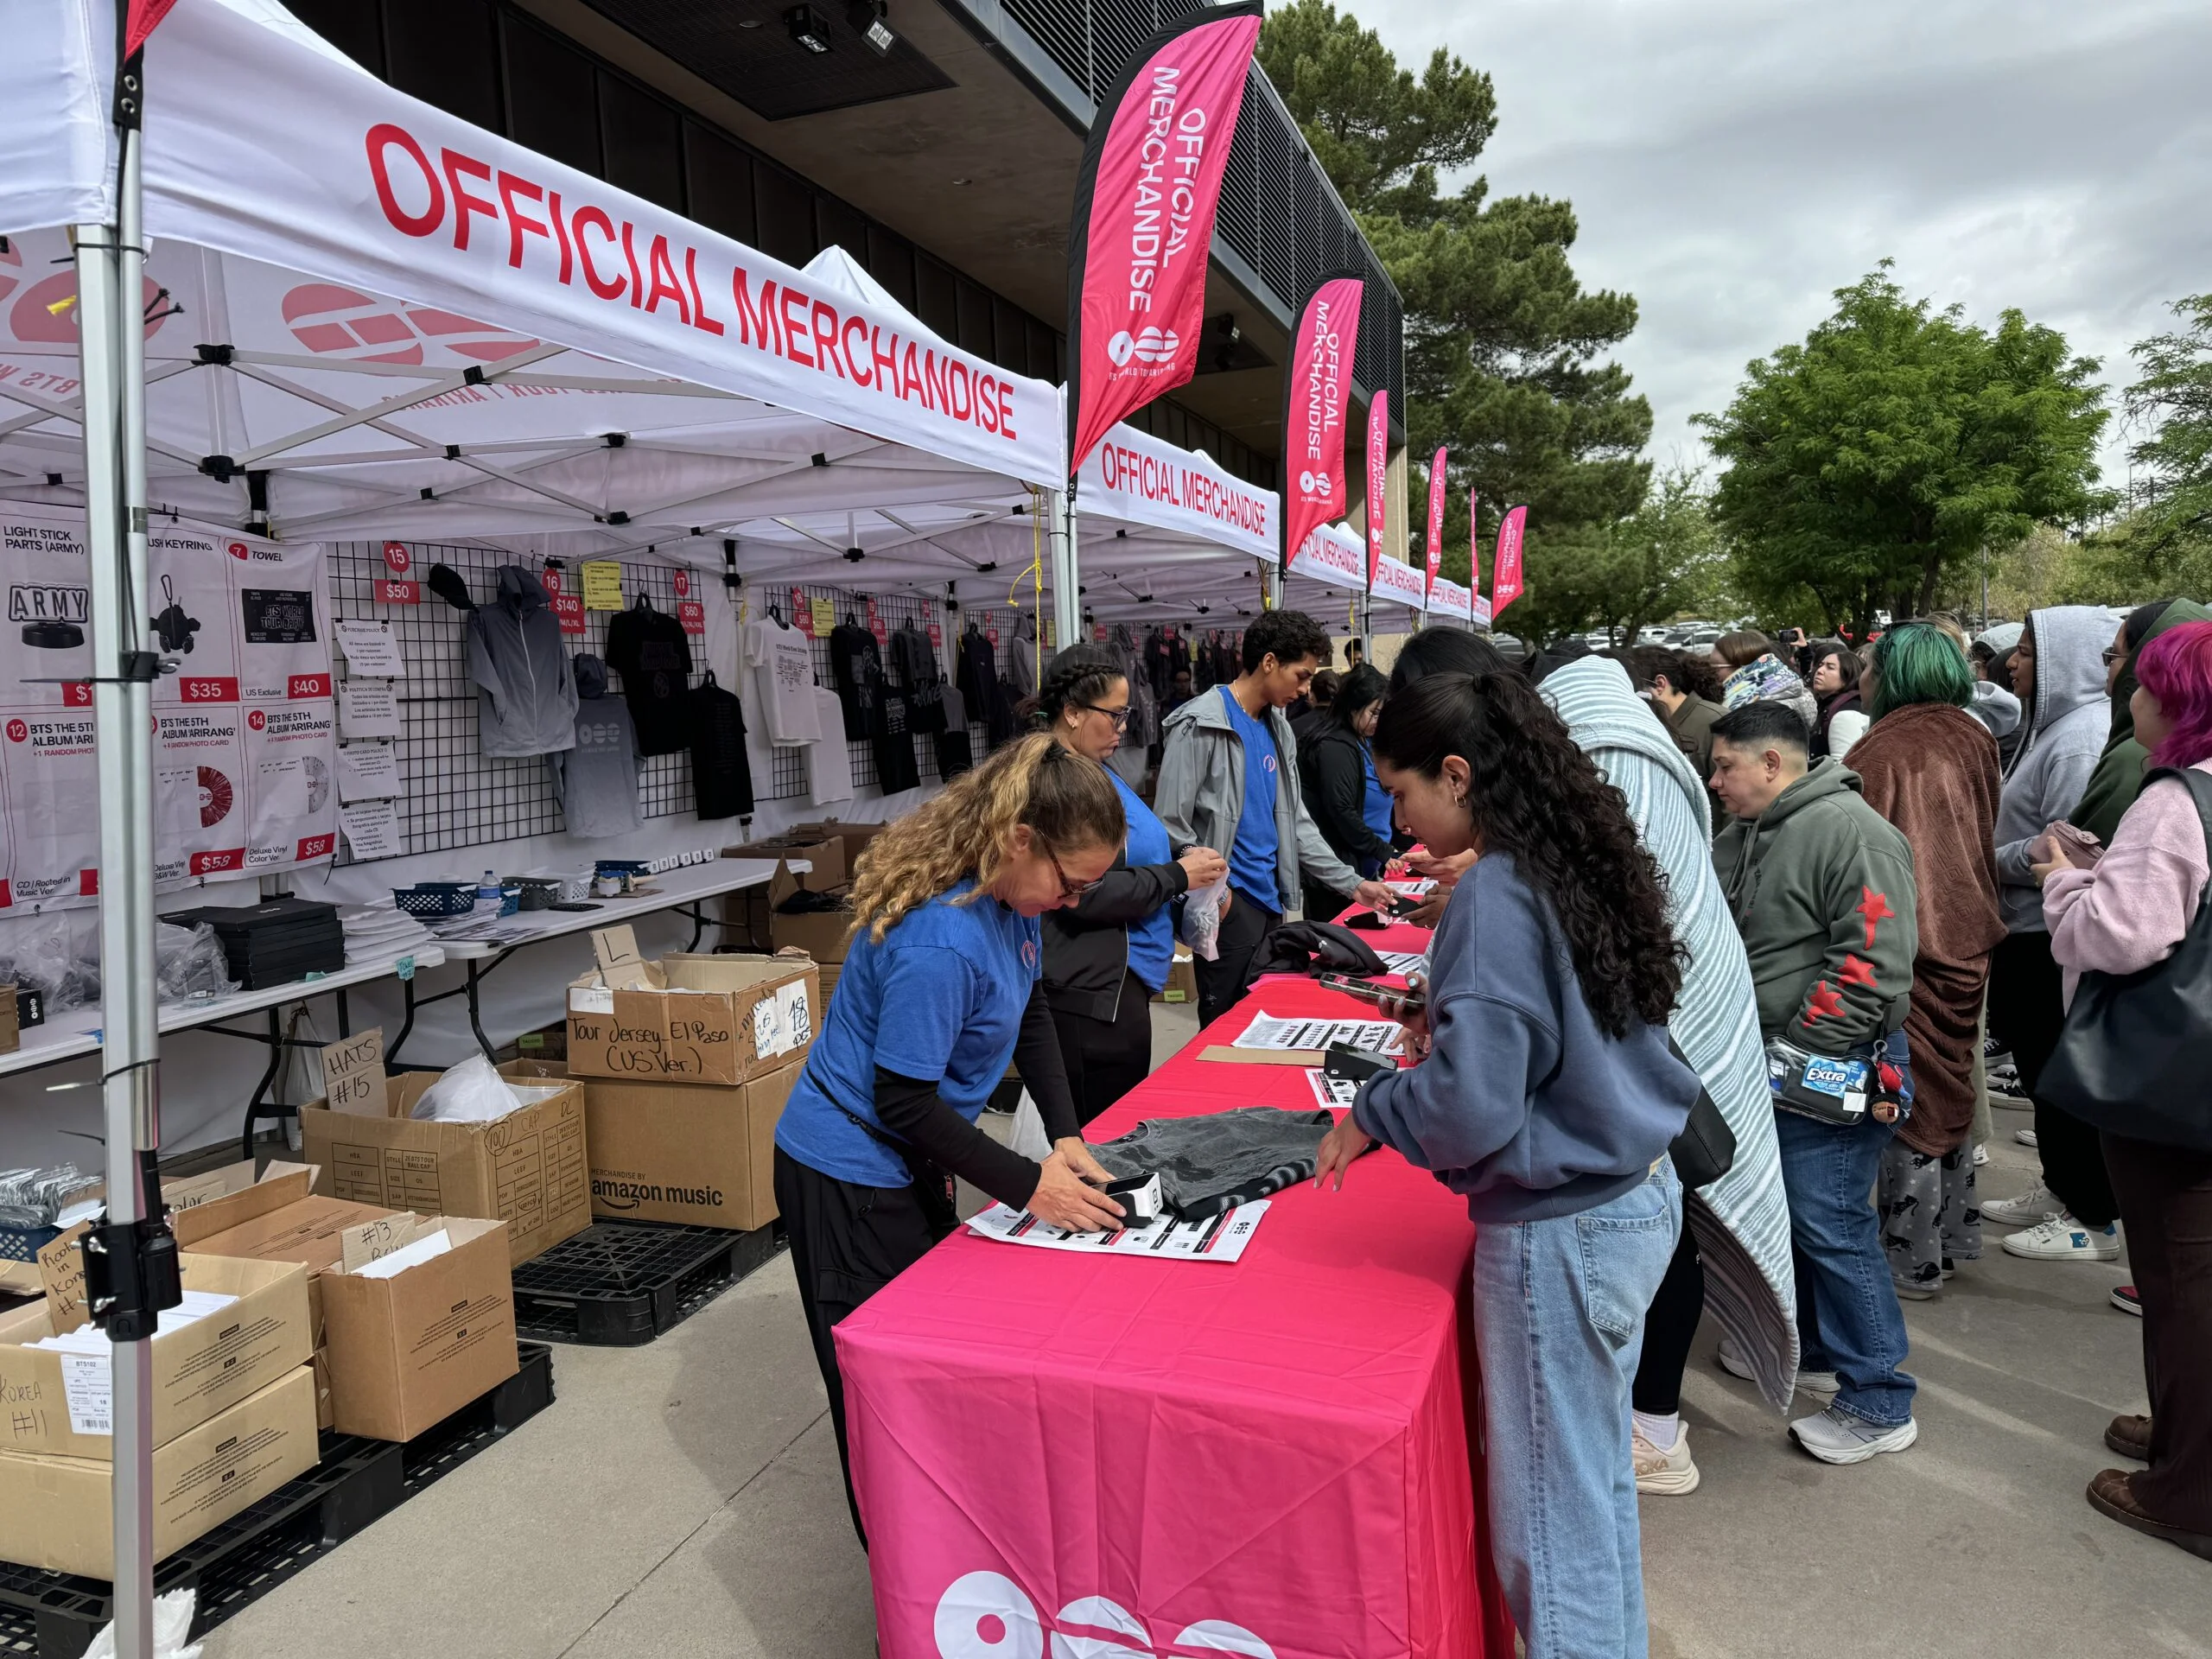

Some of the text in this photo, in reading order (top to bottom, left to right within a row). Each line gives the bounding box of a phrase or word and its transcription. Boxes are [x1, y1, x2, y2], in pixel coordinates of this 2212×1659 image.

[1128, 67, 1179, 313] MERCHANDISE
[1163, 108, 1206, 268] OFFICIAL
[365, 123, 1017, 441] OFFICIAL MERCHANDISE
[1324, 333, 1339, 432] OFFICIAL
[1102, 442, 1266, 537] OFFICIAL MERCHANDISE
[3, 525, 71, 541] LIGHT STICK
[5, 539, 85, 556] PARTS (ARMY)
[148, 537, 213, 551] USH KEYRING
[233, 547, 242, 557] 7
[251, 550, 283, 563] TOWEL
[389, 549, 405, 564] 15
[546, 575, 558, 590] 16
[677, 577, 685, 589] 17
[386, 583, 409, 599] $50
[13, 588, 87, 619] ARMY
[556, 598, 578, 612] $140
[684, 605, 698, 617] $60
[190, 681, 222, 698] $35
[245, 688, 282, 697] US Exclusive
[293, 679, 320, 696] $40
[161, 717, 209, 728] BTS THE 5TH
[251, 715, 264, 725] 14
[267, 712, 311, 723] BTS THE 5TH
[10, 724, 24, 737] 12
[30, 723, 53, 734] BTS
[56, 722, 76, 734] THE
[267, 723, 289, 734] ALBUM
[32, 734, 73, 747] ALBUM
[44, 748, 77, 757] RANDOM
[249, 848, 272, 856] Deluxe
[305, 839, 325, 856] $58
[201, 855, 232, 871] $58
[249, 854, 268, 863] Color
[35, 877, 63, 887] Rooted
[602, 932, 630, 963] L
[788, 996, 808, 1032] 18
[569, 1017, 601, 1041] Tour
[691, 1020, 728, 1043] Paso
[329, 1039, 377, 1075] HATS
[1806, 1067, 1847, 1082] Extra
[333, 1074, 371, 1103] #15
[521, 1112, 540, 1132] CAP
[490, 1126, 505, 1149] 100
[591, 1168, 636, 1179] MERCHANDISE
[592, 1179, 662, 1201] amazon
[666, 1185, 723, 1206] music
[174, 1193, 207, 1211] olor
[41, 1243, 71, 1268] Root
[57, 1262, 69, 1274] in
[0, 1374, 41, 1404] KOREA
[1635, 1459, 1669, 1476] OKA
